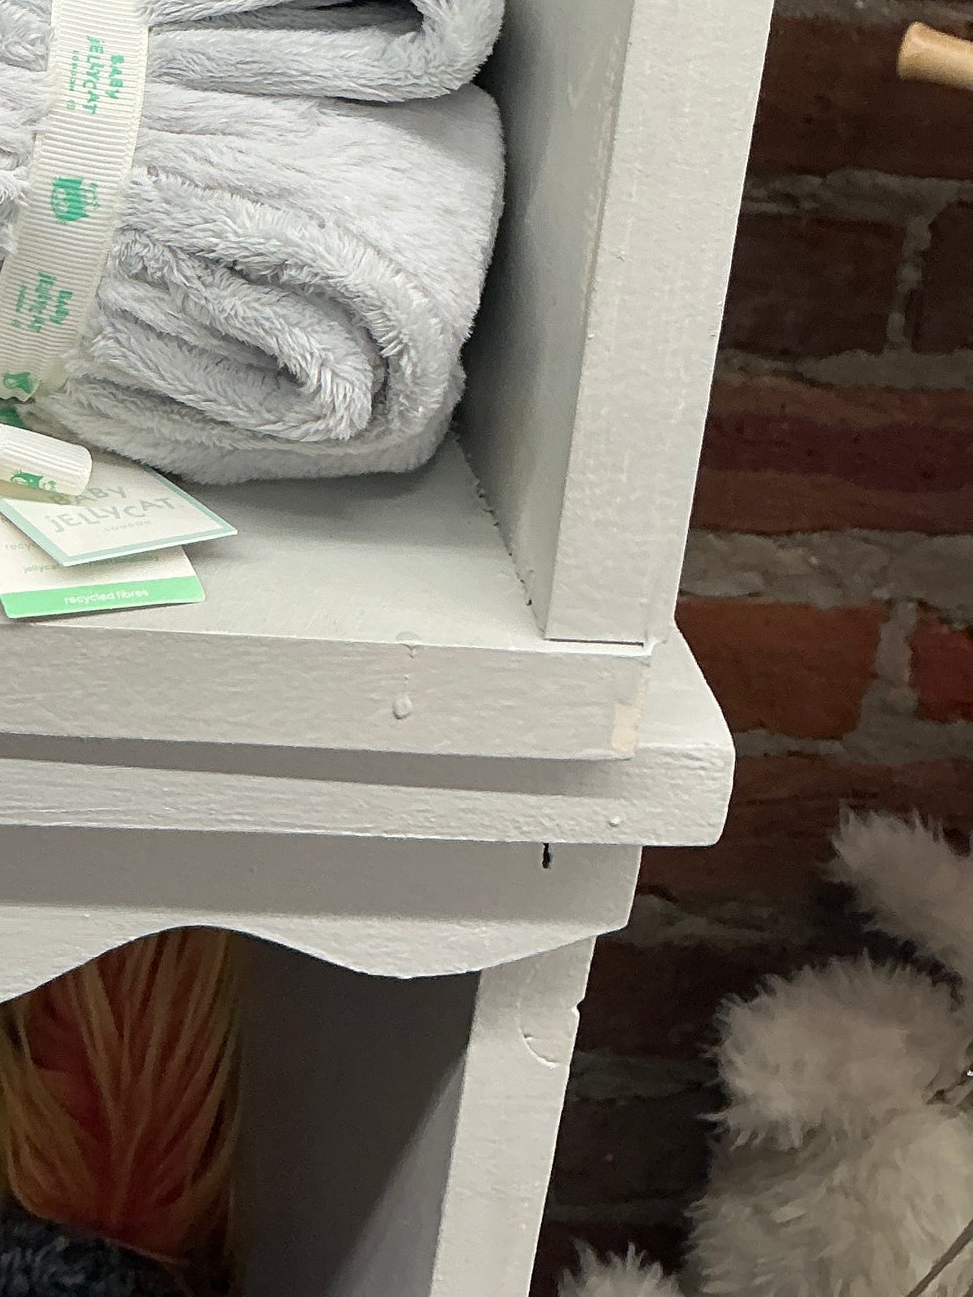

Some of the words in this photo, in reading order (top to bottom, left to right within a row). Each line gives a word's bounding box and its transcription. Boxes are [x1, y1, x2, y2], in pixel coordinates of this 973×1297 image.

[105, 55, 125, 99] BABY
[64, 591, 115, 605] recycled
[116, 589, 149, 599] fibres
